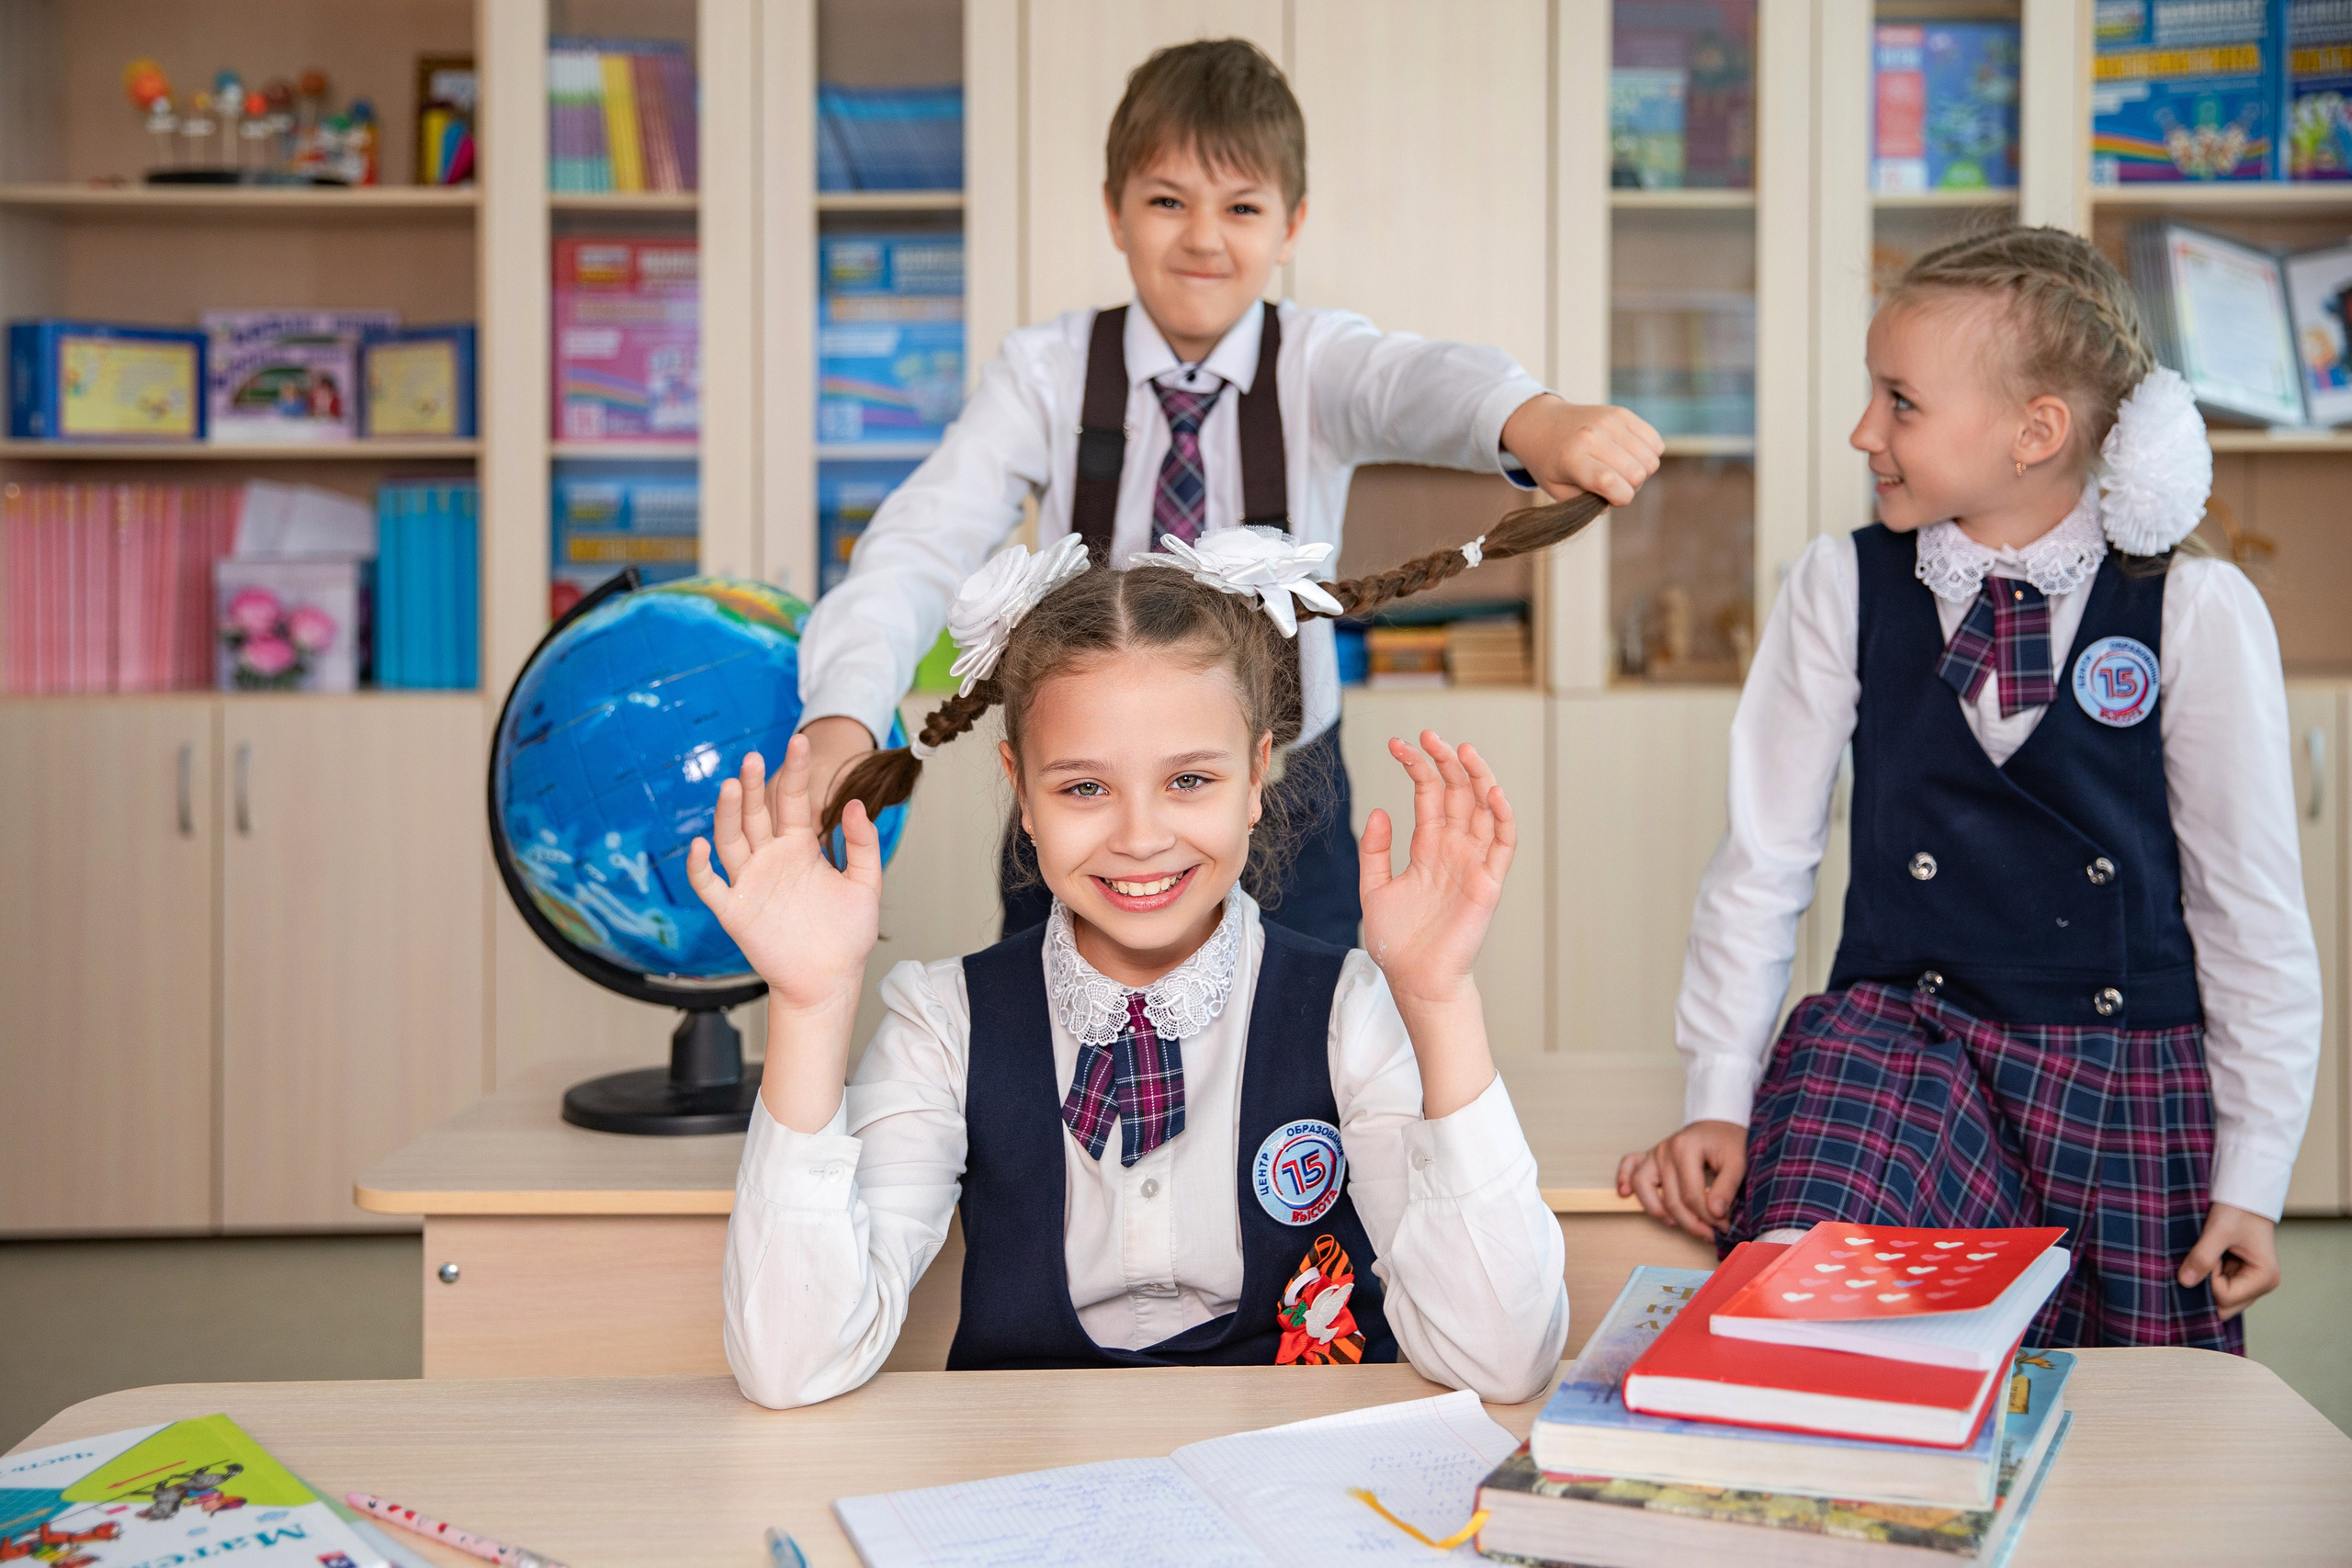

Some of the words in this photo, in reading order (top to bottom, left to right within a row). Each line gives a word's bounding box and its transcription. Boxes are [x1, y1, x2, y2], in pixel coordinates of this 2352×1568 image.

[2098, 667, 2138, 699] 15
[1258, 1152, 1270, 1196] ЦЕНТР
[1282, 1148, 1327, 1195] 15
[1291, 1190, 1338, 1223] ВЫСОТА
[11, 1451, 95, 1472] Часть
